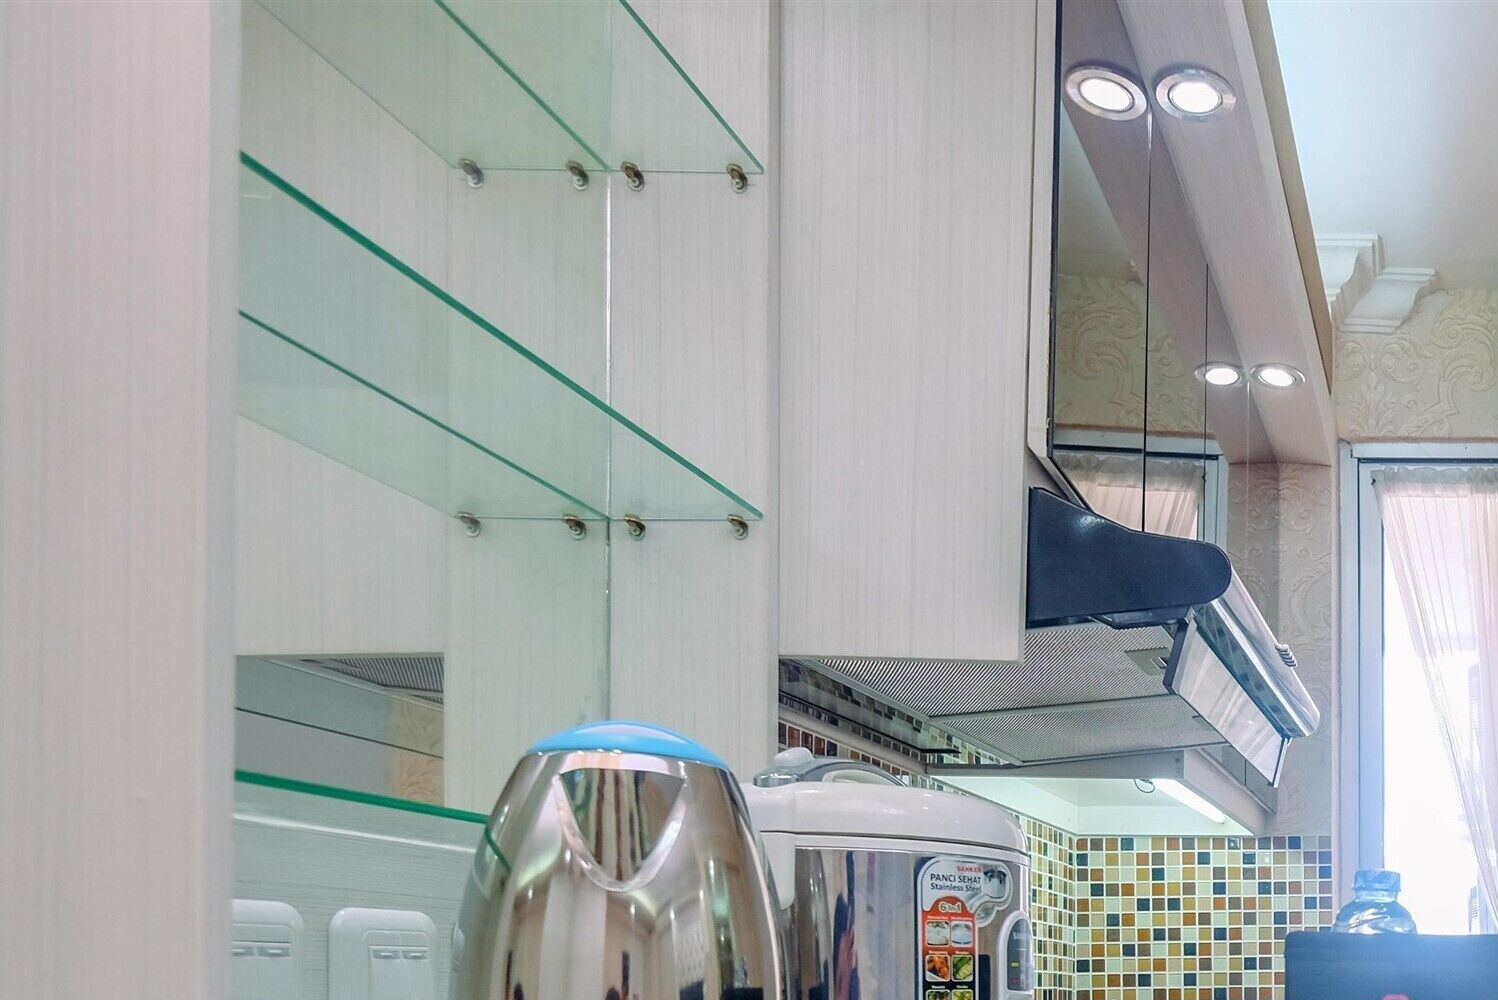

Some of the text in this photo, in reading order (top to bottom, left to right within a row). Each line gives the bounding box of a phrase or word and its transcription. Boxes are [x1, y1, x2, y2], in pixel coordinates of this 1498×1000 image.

[930, 873, 981, 884] PANCI SEHAT
[930, 882, 982, 893] Stainless Steel
